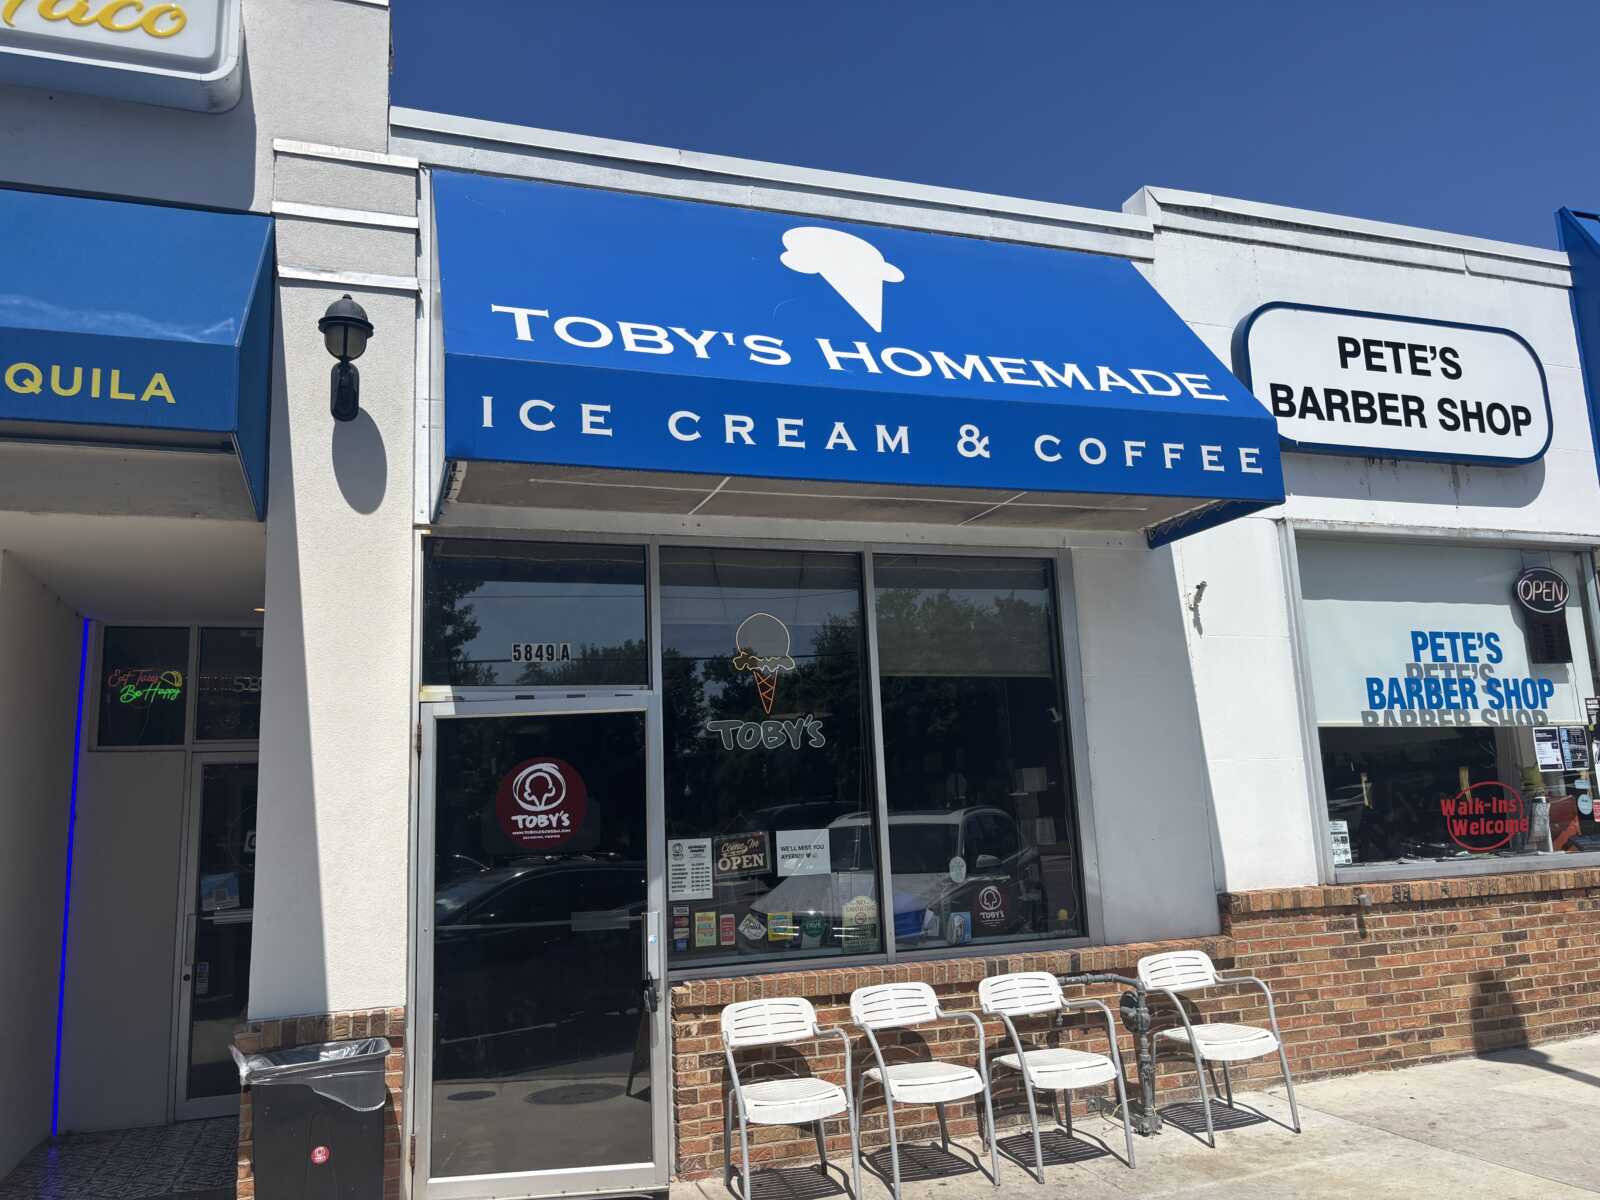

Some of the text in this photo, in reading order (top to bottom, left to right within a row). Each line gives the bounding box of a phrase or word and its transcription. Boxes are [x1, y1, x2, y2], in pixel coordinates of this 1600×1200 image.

[491, 304, 1229, 402] TOBY'S HOMEMADE
[1337, 336, 1463, 380] PETE'S
[5, 362, 176, 404] QUILA
[1269, 383, 1532, 436] BARBER SHOP
[481, 396, 1264, 474] ICE CREAM & COFFEE
[1521, 580, 1563, 601] OPEN
[513, 644, 554, 661] 5849
[1410, 631, 1503, 664] PETE'S
[1366, 677, 1479, 710] BARBER
[1486, 678, 1555, 710] SHOP
[707, 714, 825, 750] TOBY'S
[511, 811, 571, 829] TOBY'S
[1453, 817, 1529, 836] Welcome
[718, 853, 765, 871] OPEN
